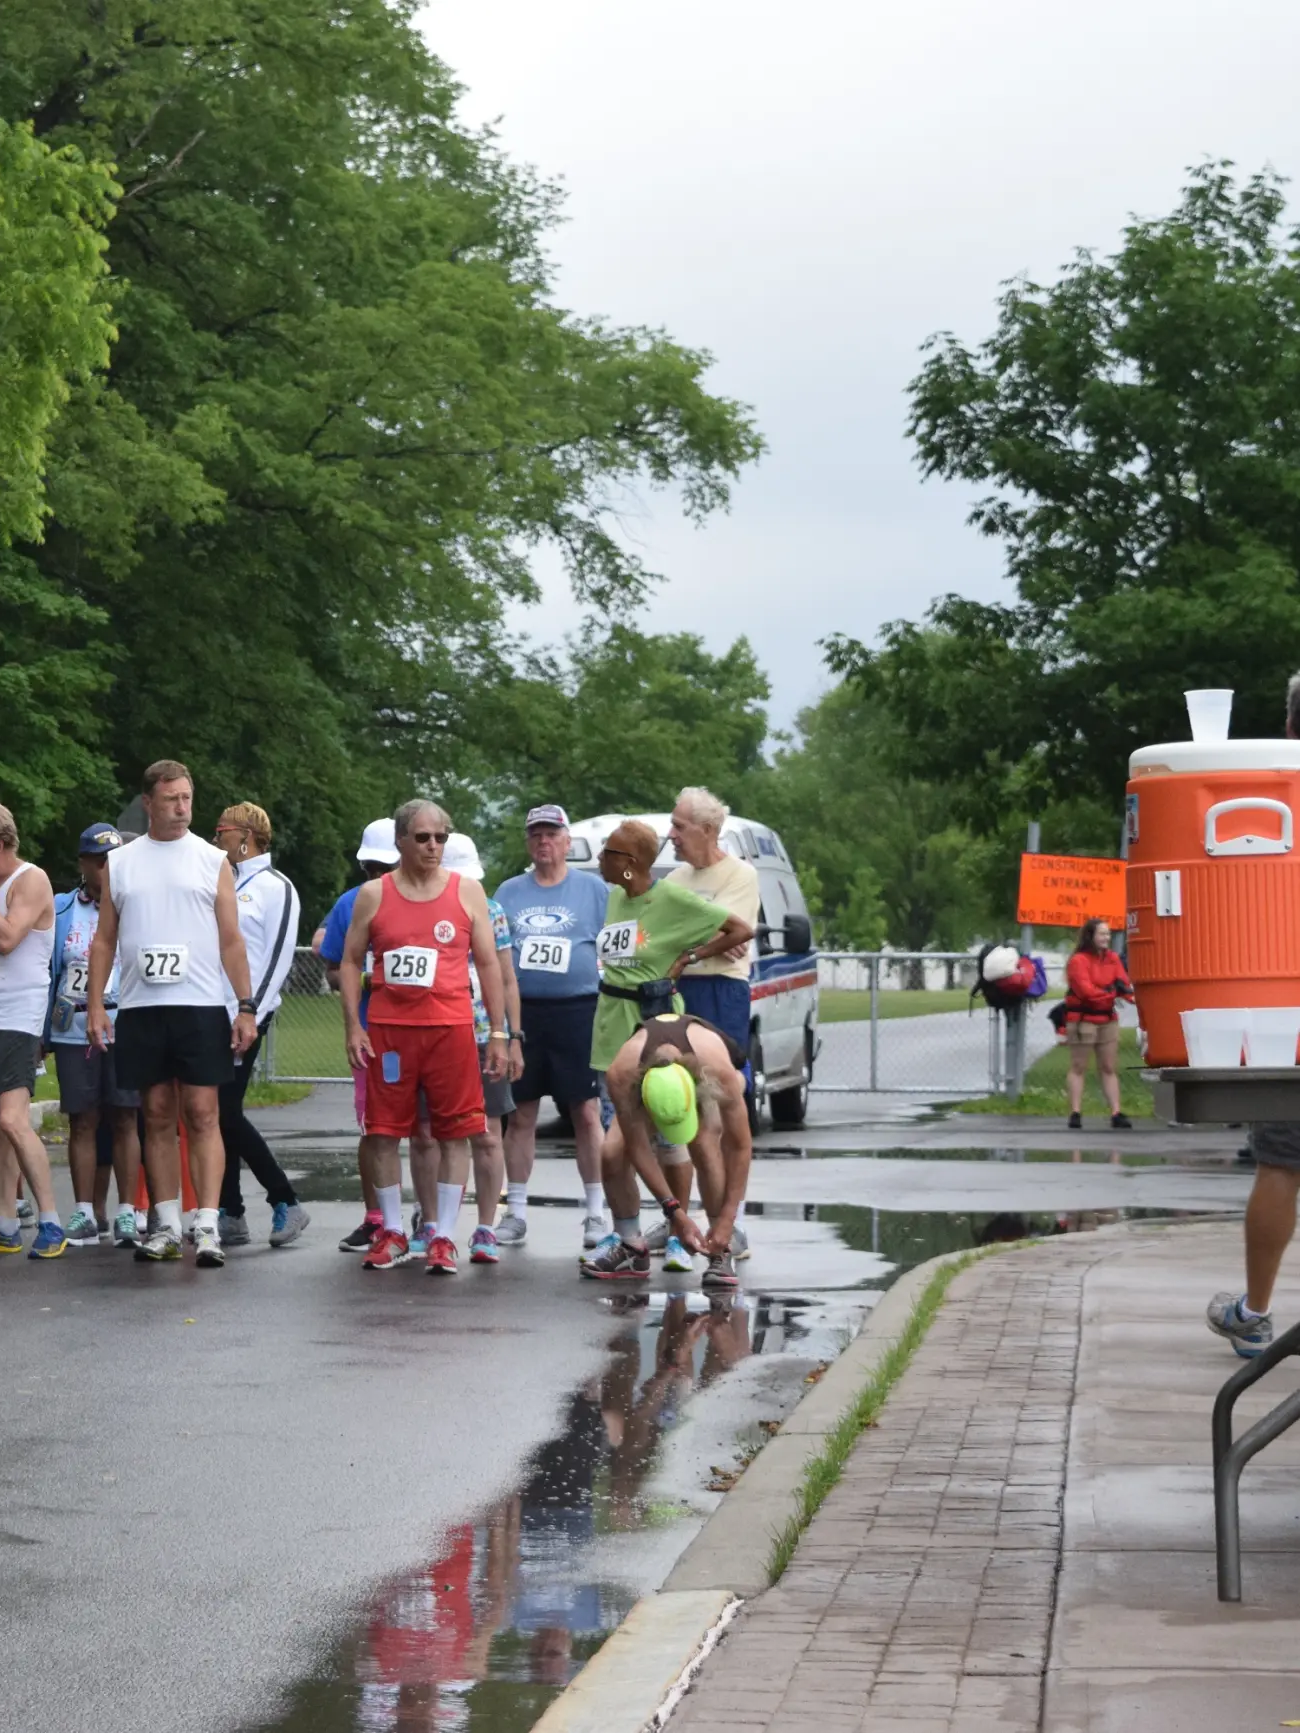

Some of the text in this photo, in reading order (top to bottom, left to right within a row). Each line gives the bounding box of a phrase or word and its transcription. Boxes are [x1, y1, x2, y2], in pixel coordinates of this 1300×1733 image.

[1030, 858, 1120, 875] CONSTRUCTION
[1042, 877, 1104, 892] ENTRANCE
[1057, 894, 1087, 907] ONLY
[1020, 910, 1036, 921] NO
[1041, 911, 1072, 923] THRU
[602, 928, 630, 953] 248
[528, 943, 563, 965] 250
[145, 953, 180, 976] 272
[391, 954, 427, 977] 258
